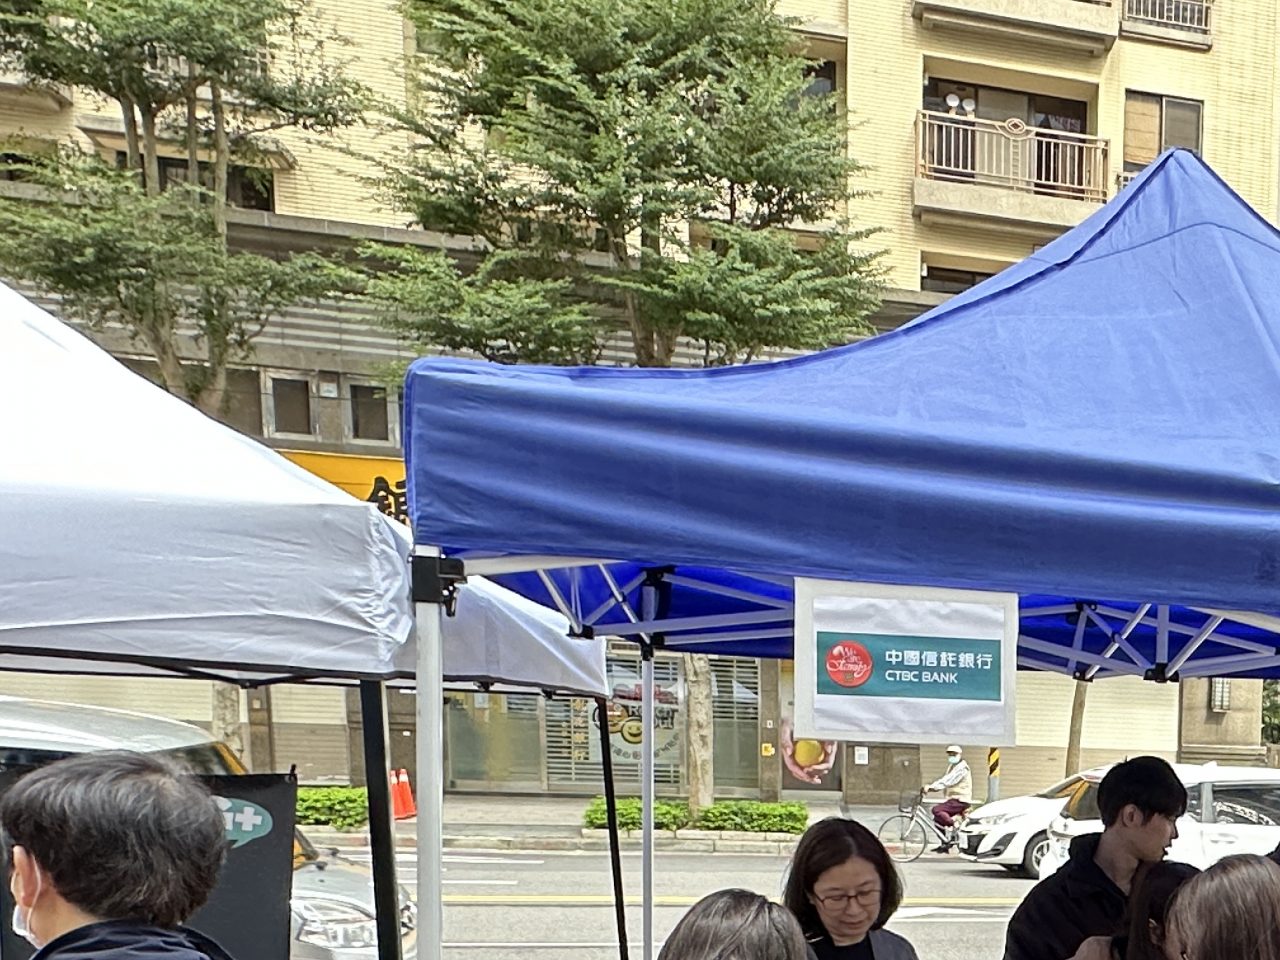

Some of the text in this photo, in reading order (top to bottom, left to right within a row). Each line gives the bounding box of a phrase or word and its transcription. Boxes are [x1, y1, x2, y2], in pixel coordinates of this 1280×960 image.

[885, 649, 993, 669] 中國信託銀行
[885, 670, 959, 684] CTBC BANK
